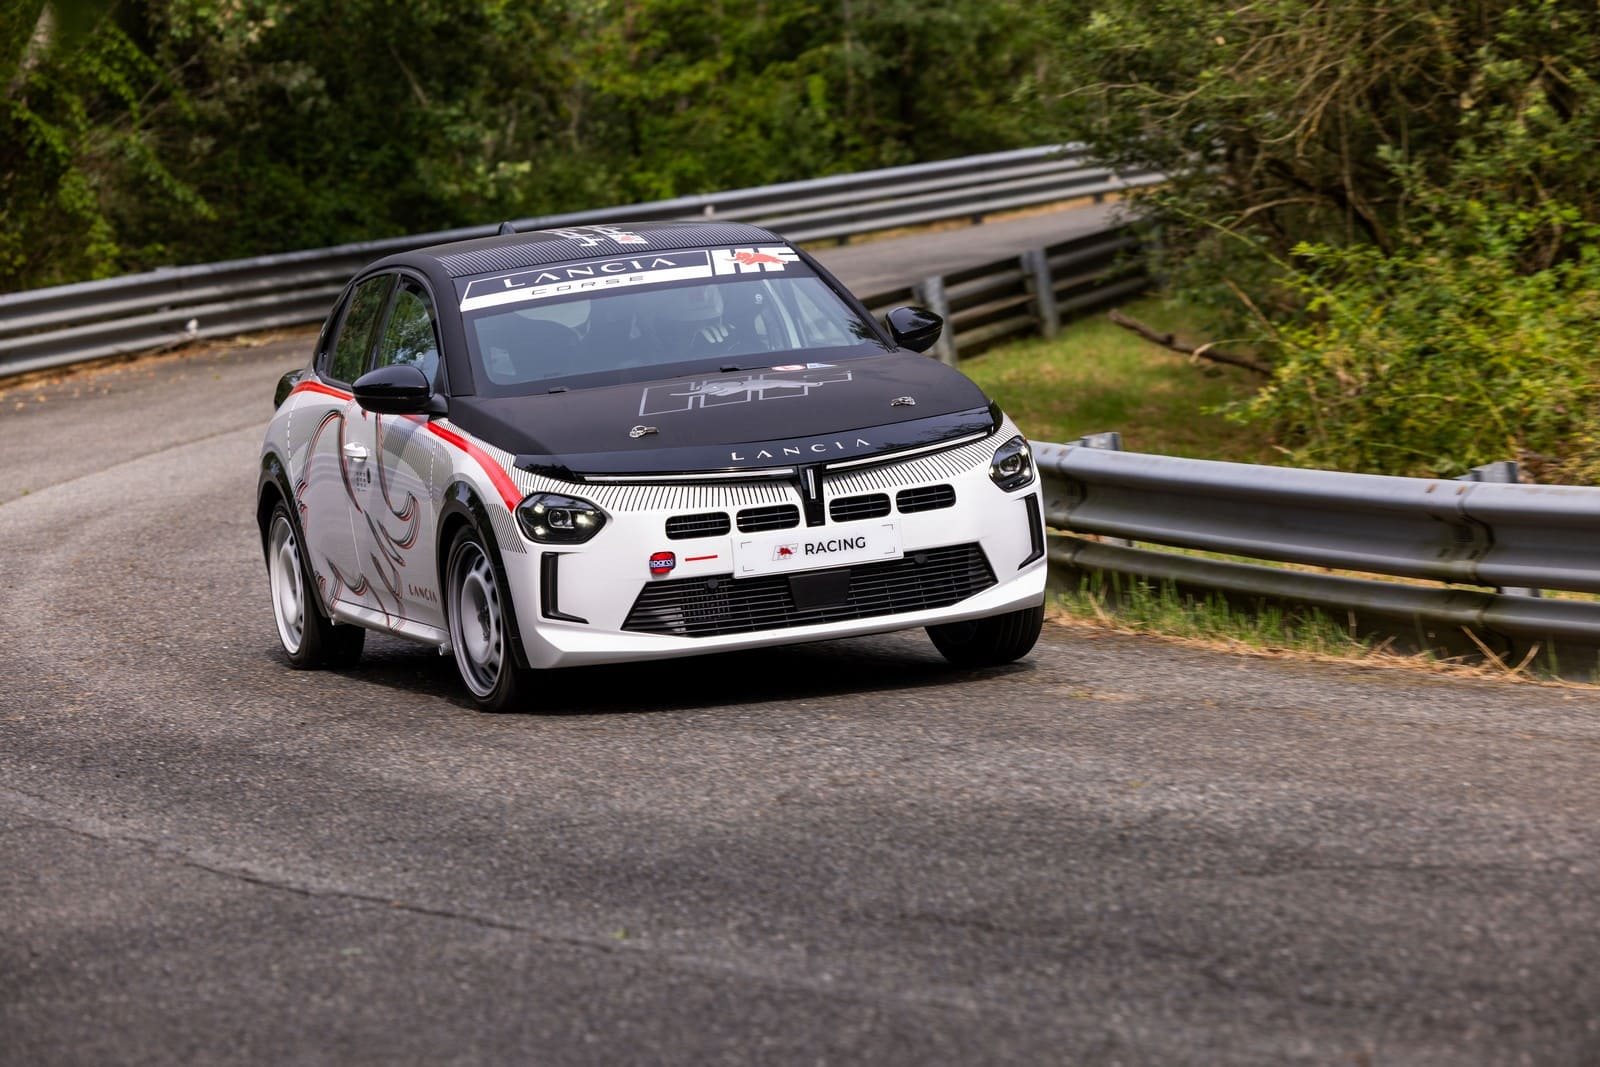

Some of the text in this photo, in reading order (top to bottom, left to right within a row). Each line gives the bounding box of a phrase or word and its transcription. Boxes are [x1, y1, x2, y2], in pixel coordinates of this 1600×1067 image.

[503, 257, 677, 288] LANCIA
[531, 275, 643, 296] CORSE
[731, 438, 870, 461] LANCIA
[804, 536, 866, 556] RACING
